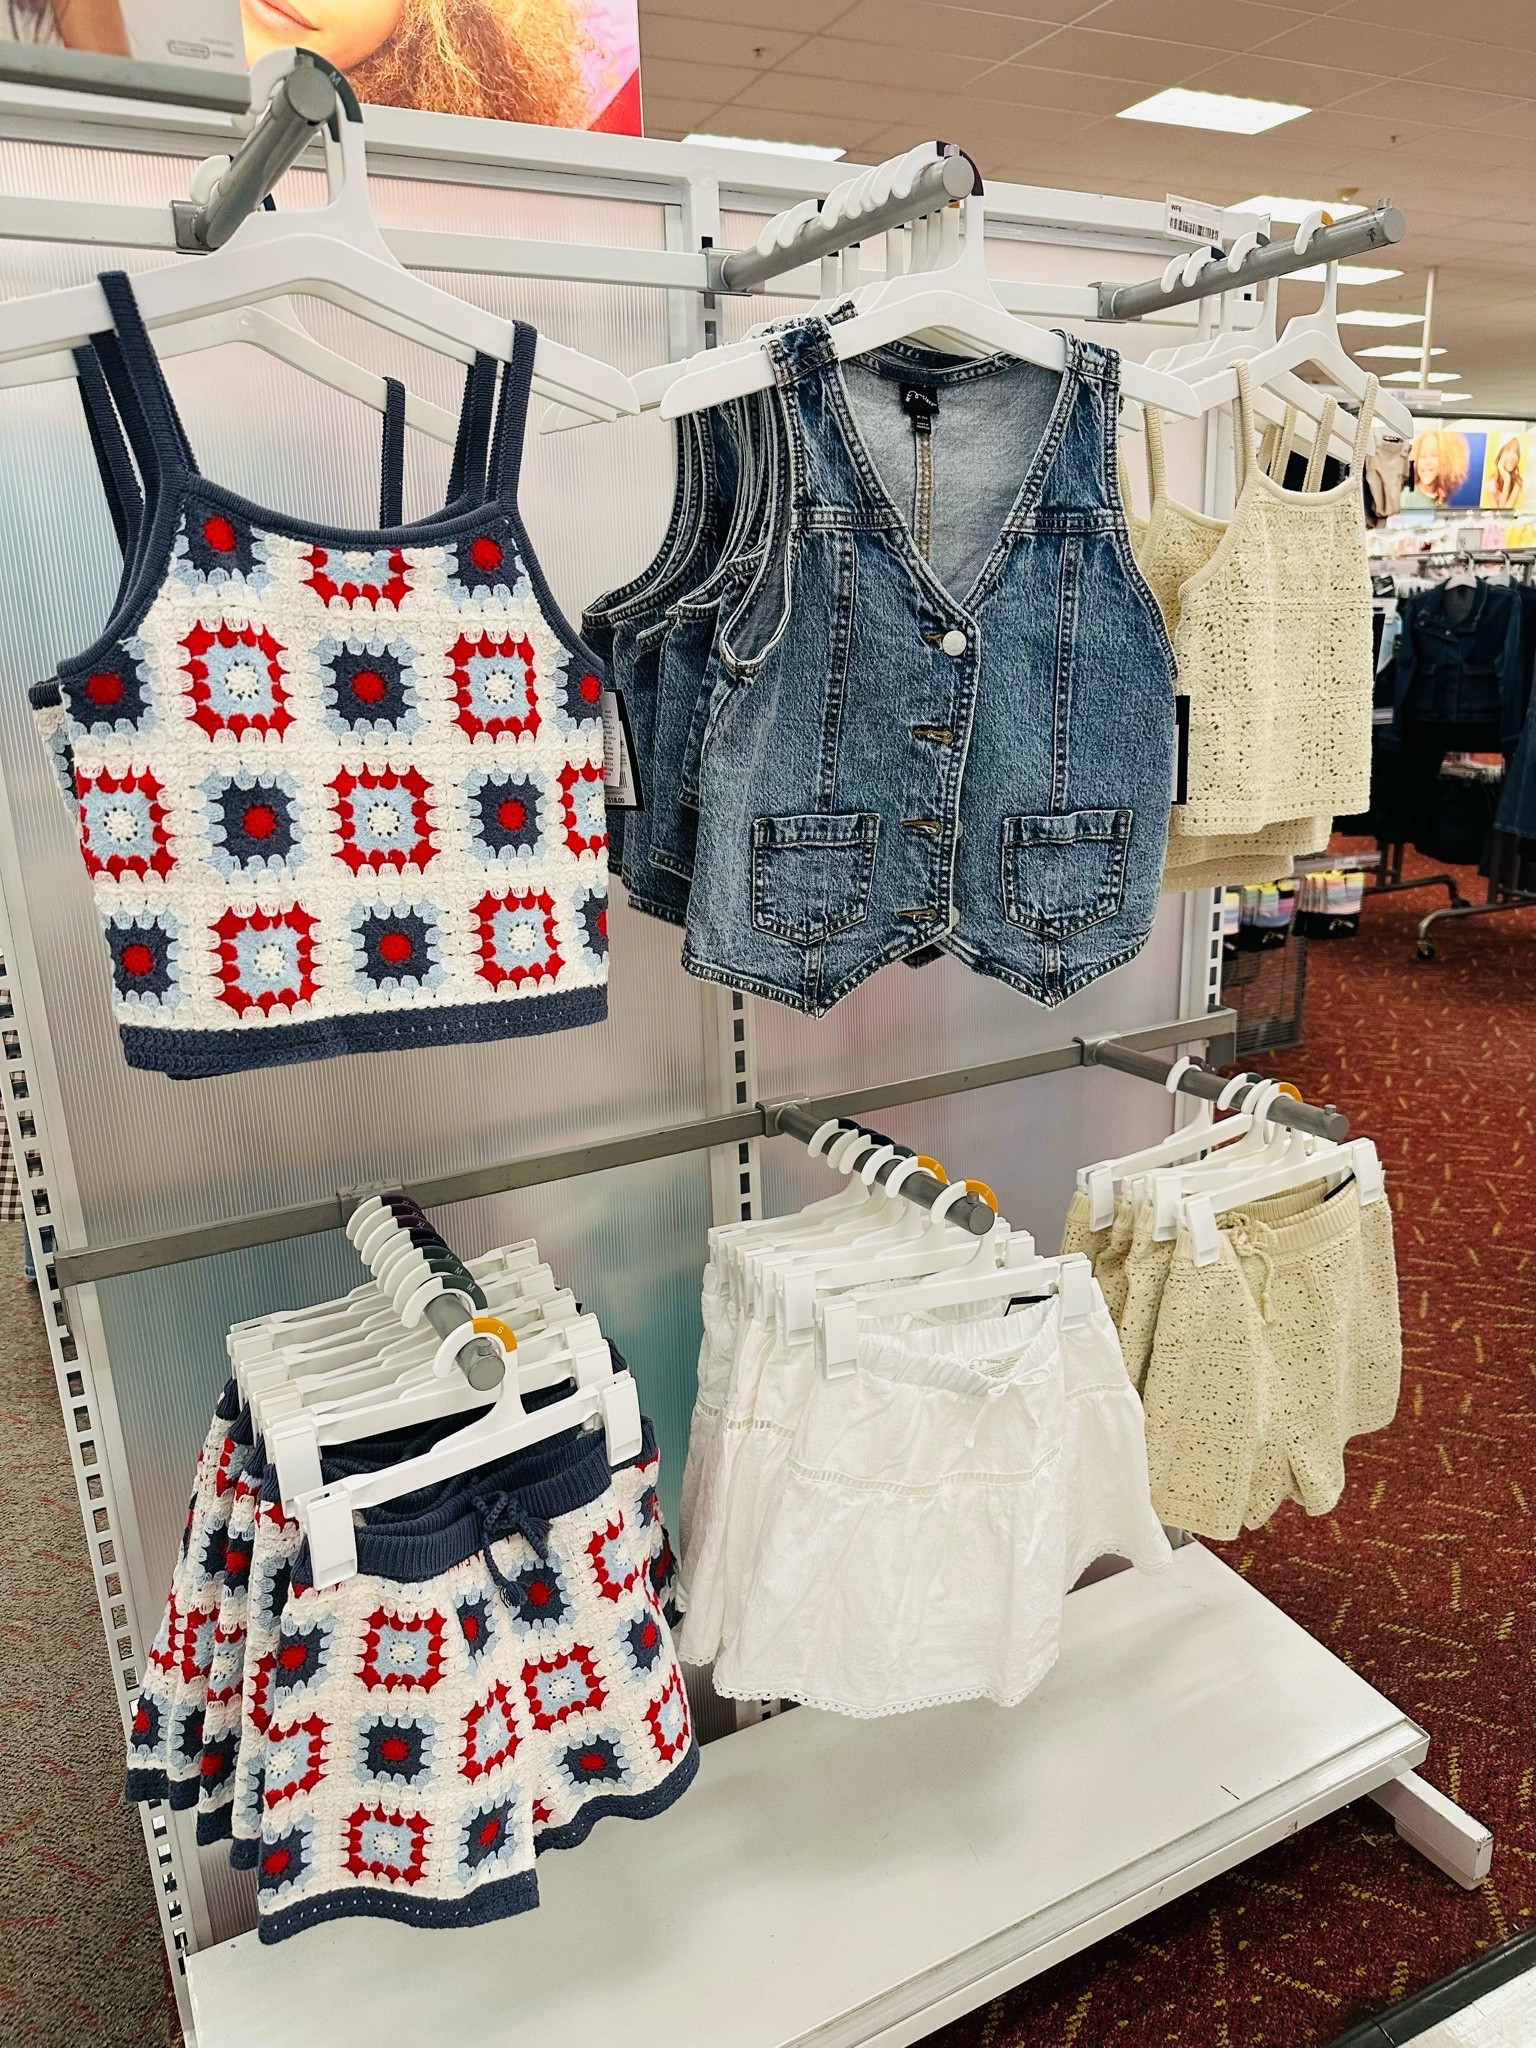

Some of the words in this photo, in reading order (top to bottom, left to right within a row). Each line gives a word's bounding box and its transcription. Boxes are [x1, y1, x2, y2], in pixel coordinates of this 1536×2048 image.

[329, 70, 342, 86] M
[454, 1266, 464, 1275] M
[466, 1283, 476, 1292] M
[497, 1326, 504, 1334] S
